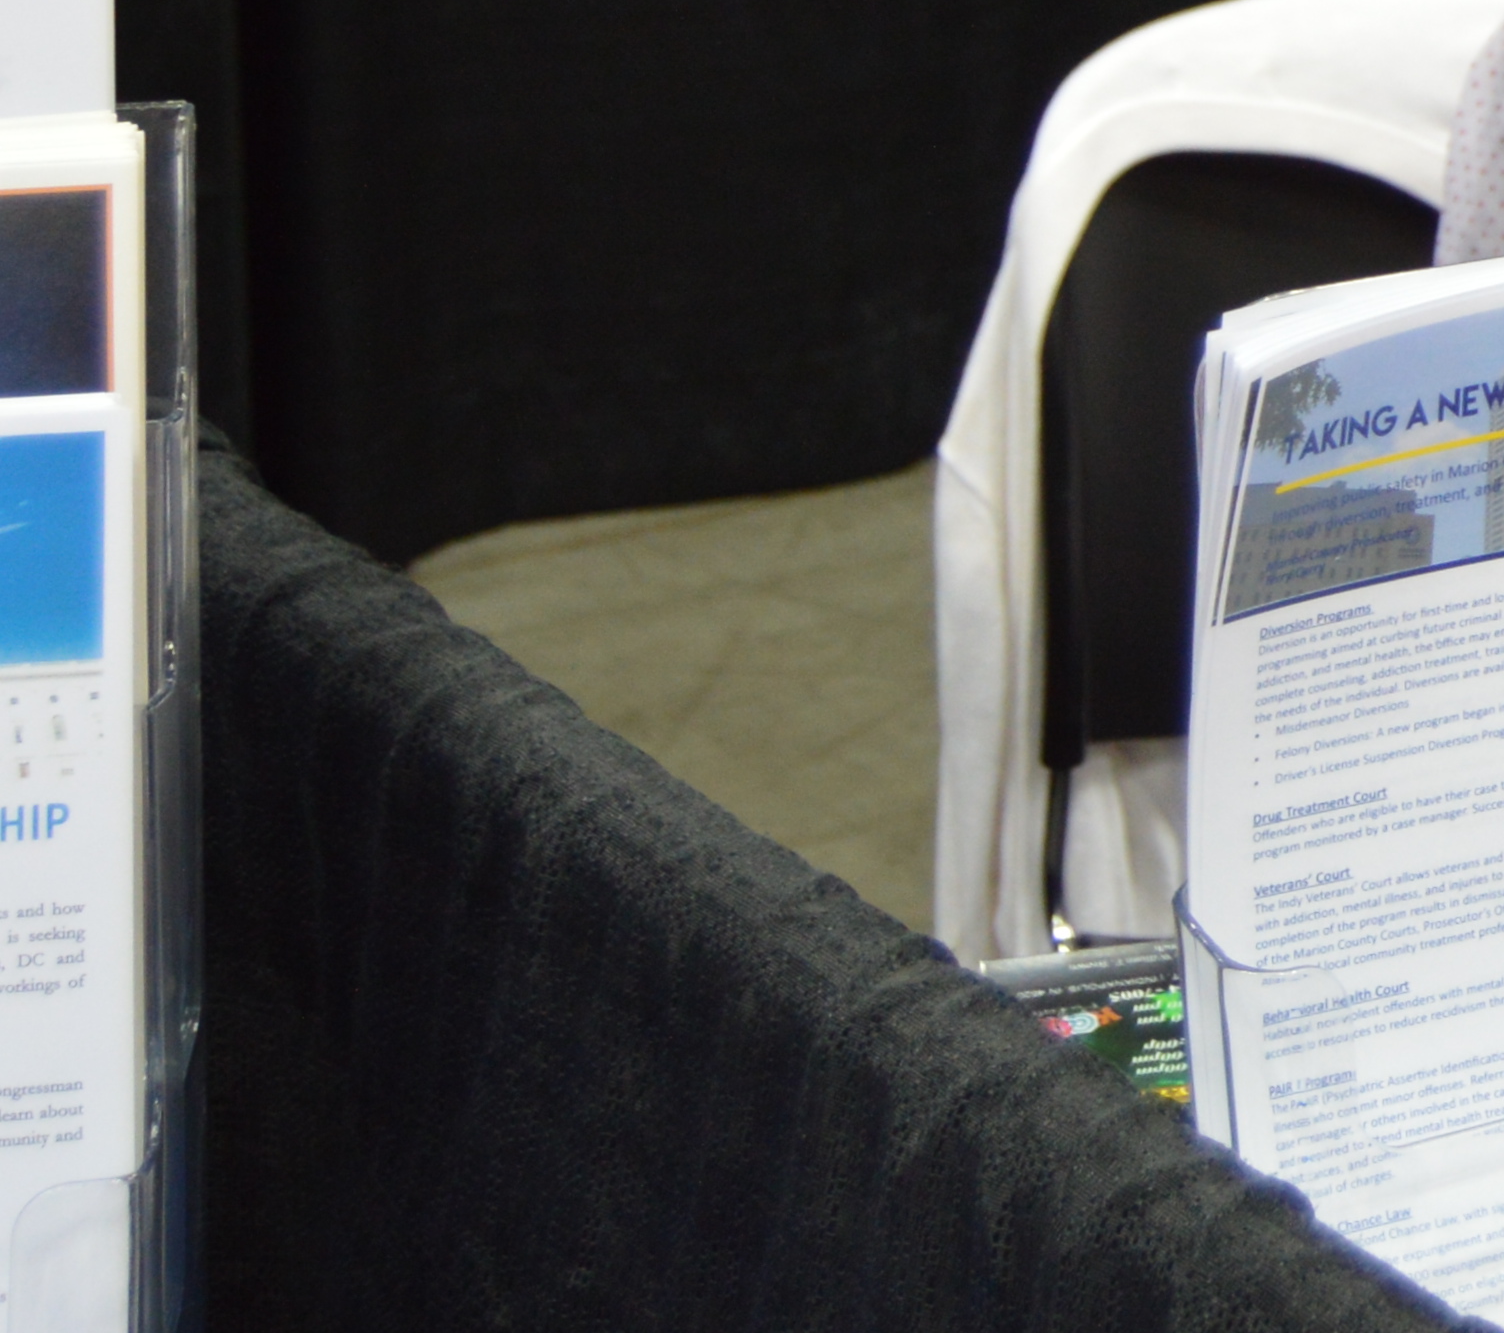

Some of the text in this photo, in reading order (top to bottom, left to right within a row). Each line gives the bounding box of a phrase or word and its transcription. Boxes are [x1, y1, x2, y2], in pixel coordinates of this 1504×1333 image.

[1283, 404, 1398, 466] TAKING
[1406, 398, 1428, 429] A
[1341, 483, 1383, 508] public
[1385, 471, 1427, 496] safety
[1431, 467, 1443, 483] in
[1448, 453, 1499, 479] Marion
[1325, 503, 1391, 529] diversion,
[1395, 488, 1470, 514] treatment,
[1475, 480, 1500, 496] and
[1260, 604, 1372, 639] Diversion Programs
[1275, 700, 1409, 736] Misdemeanor Diversions
[1275, 744, 1310, 760] Felony
[1376, 728, 1384, 737] A
[1387, 723, 1410, 734] new
[1413, 714, 1460, 732] program
[1463, 707, 1495, 721] began
[1275, 766, 1316, 784] Driver's
[1320, 758, 1360, 773] License
[1364, 744, 1425, 765] Suspension
[1429, 734, 1479, 752] Diversion
[1253, 788, 1387, 827] Drug Treatment Court
[1316, 868, 1350, 884] Court
[16, 900, 85, 919] and how
[8, 925, 86, 945] is seeking
[17, 949, 85, 968] DC and
[68, 975, 87, 990] of
[40, 1103, 84, 1121] about
[56, 1127, 83, 1143] and
